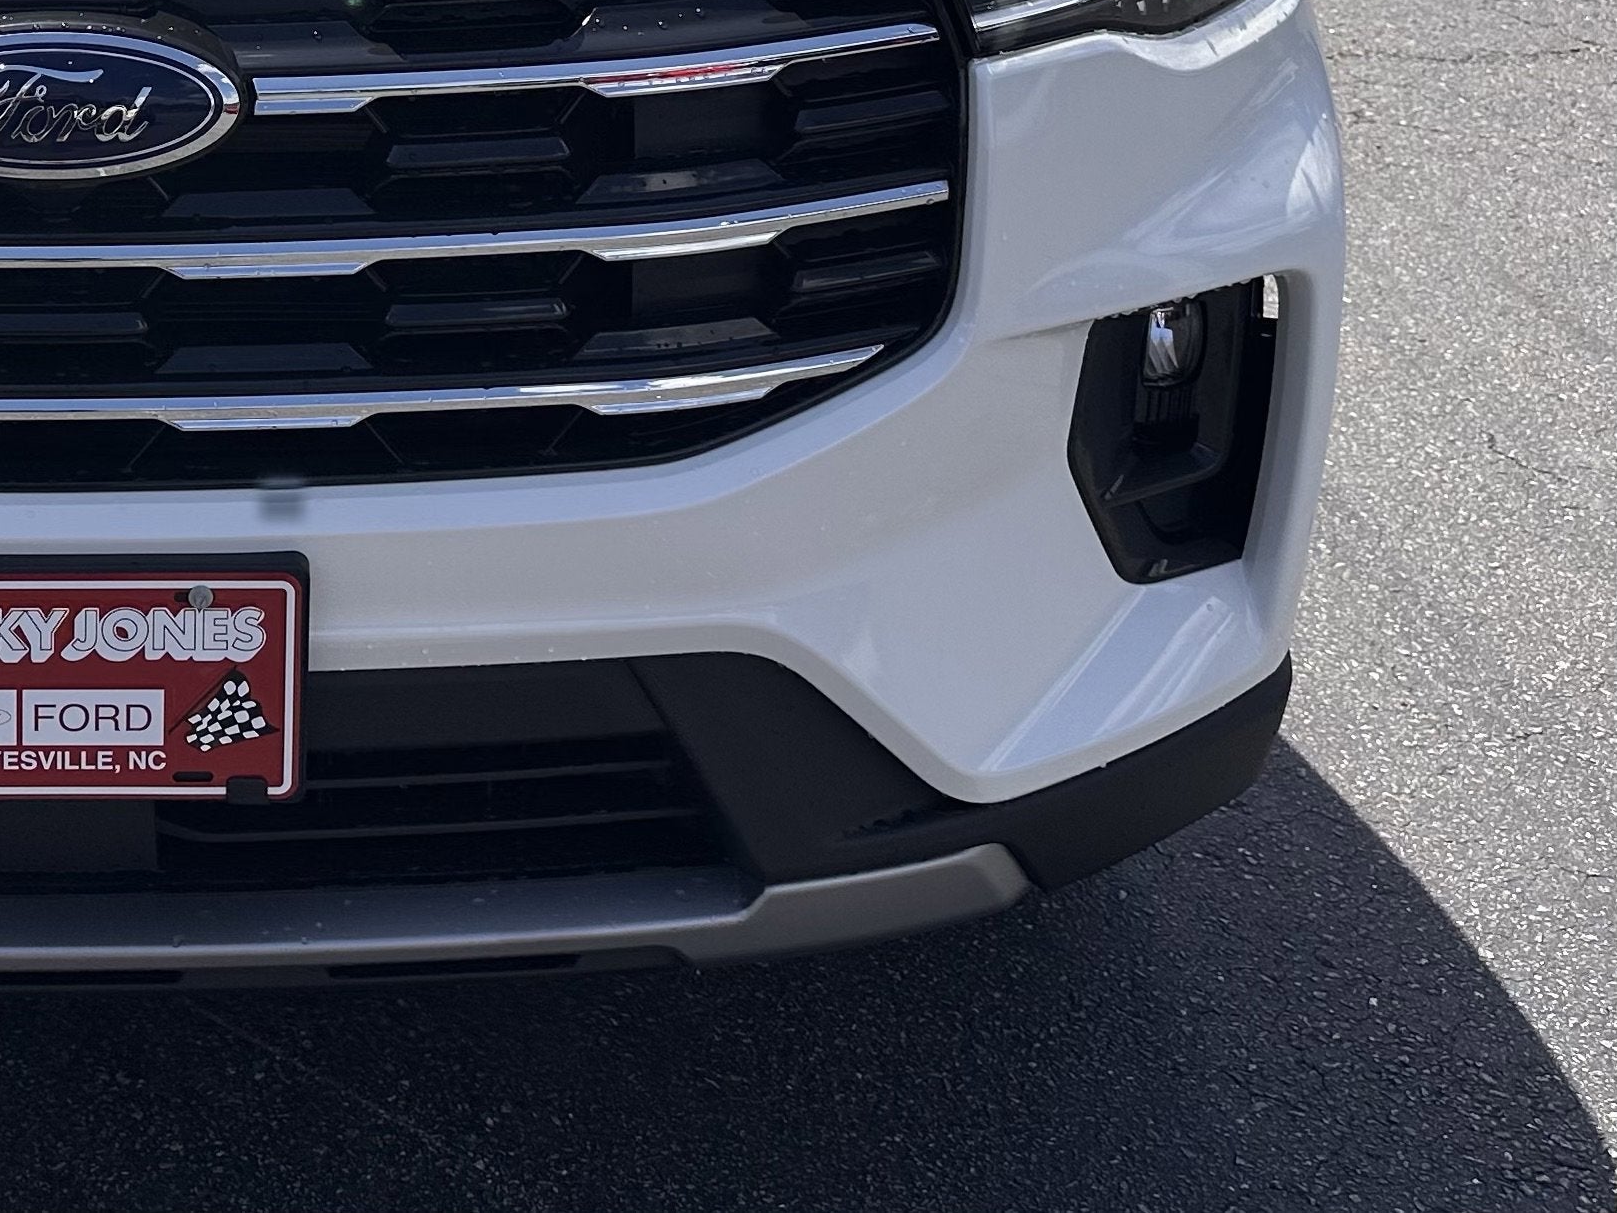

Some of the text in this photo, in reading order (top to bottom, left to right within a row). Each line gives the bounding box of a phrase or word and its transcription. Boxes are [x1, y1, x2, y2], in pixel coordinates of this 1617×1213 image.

[60, 608, 267, 662] JONES
[33, 703, 152, 732] FORD
[128, 750, 167, 770] NC
